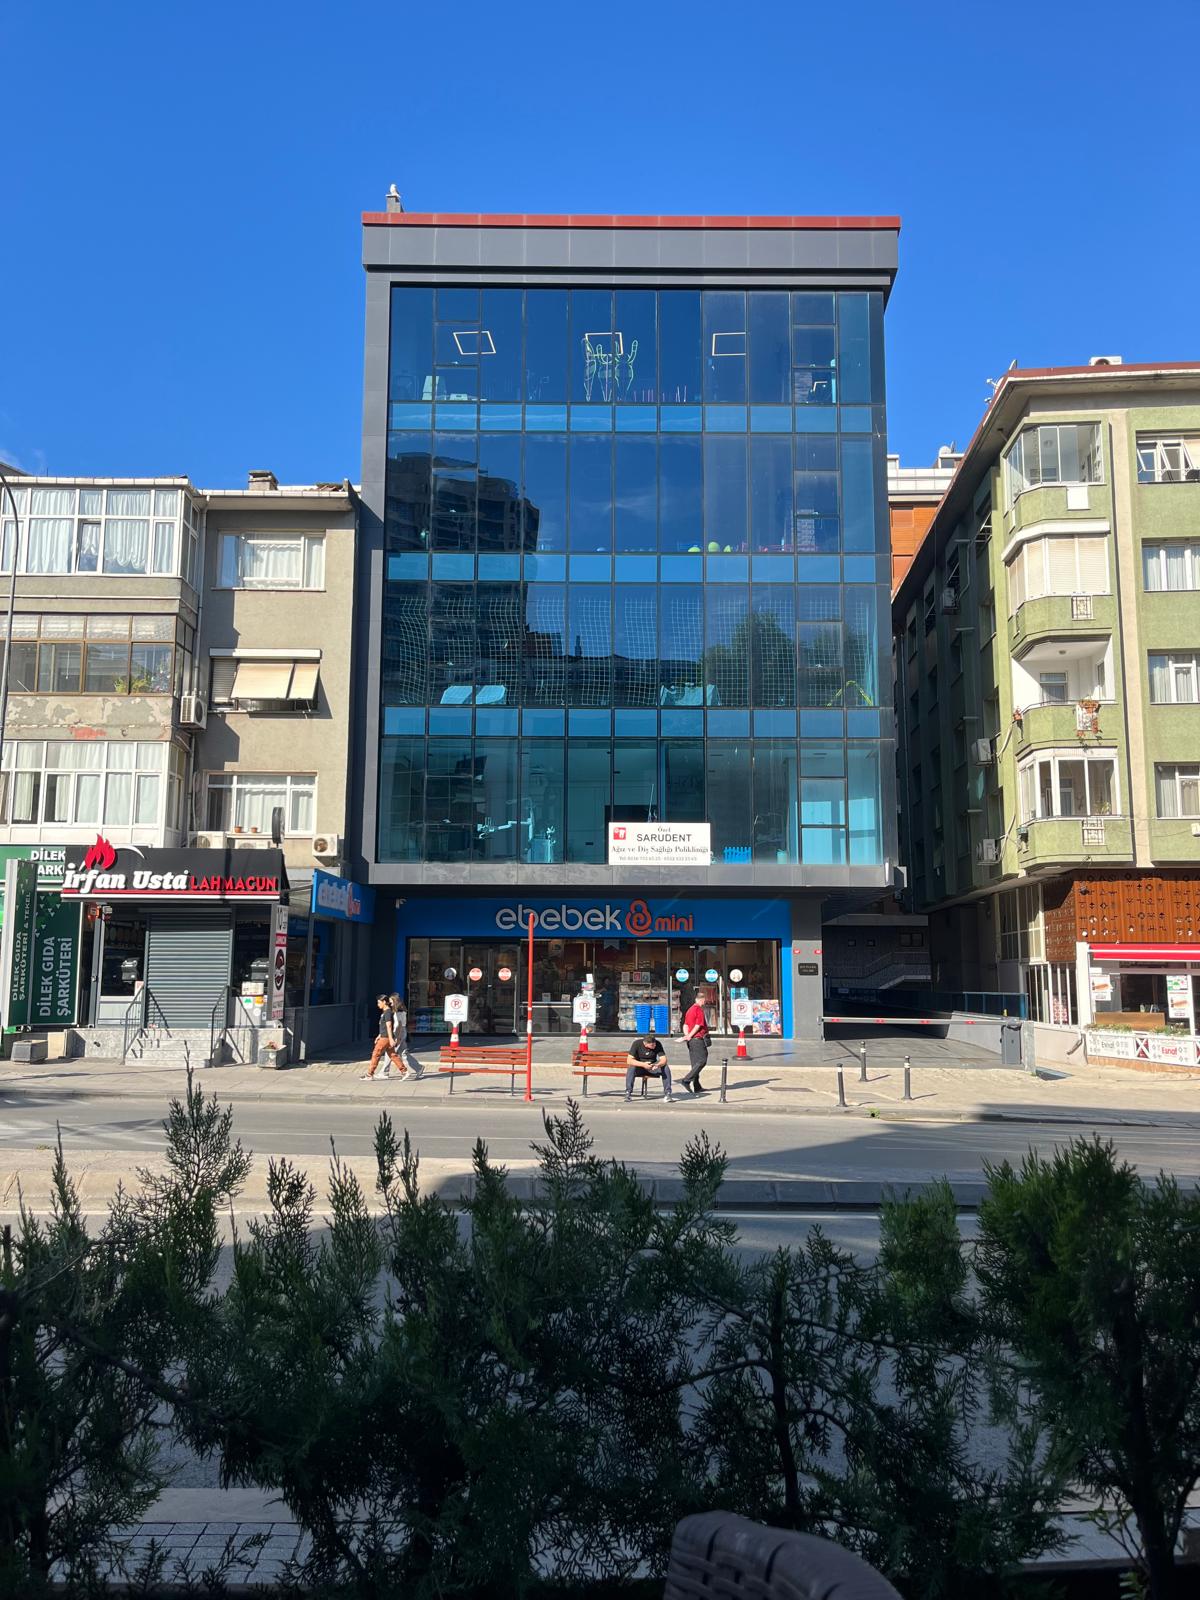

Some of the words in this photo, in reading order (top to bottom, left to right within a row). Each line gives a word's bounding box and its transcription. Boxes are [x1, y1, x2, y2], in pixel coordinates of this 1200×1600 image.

[636, 833, 692, 842] SARUDENT
[637, 846, 649, 854] Diş
[31, 848, 66, 861] DİLEK
[37, 864, 65, 875] ARK
[62, 862, 126, 894] İrfan
[190, 875, 277, 891] LAHMACUN
[495, 904, 622, 931] ebebek
[655, 914, 694, 932] mini
[19, 932, 29, 1001] ŞARKÜTERİ
[42, 936, 55, 972] GIDA
[12, 965, 20, 1001] DİLEK
[56, 937, 73, 1016] ŞARKÜTERİ
[37, 975, 53, 1016] DİLEK
[1161, 1047, 1178, 1056] Esnaf
